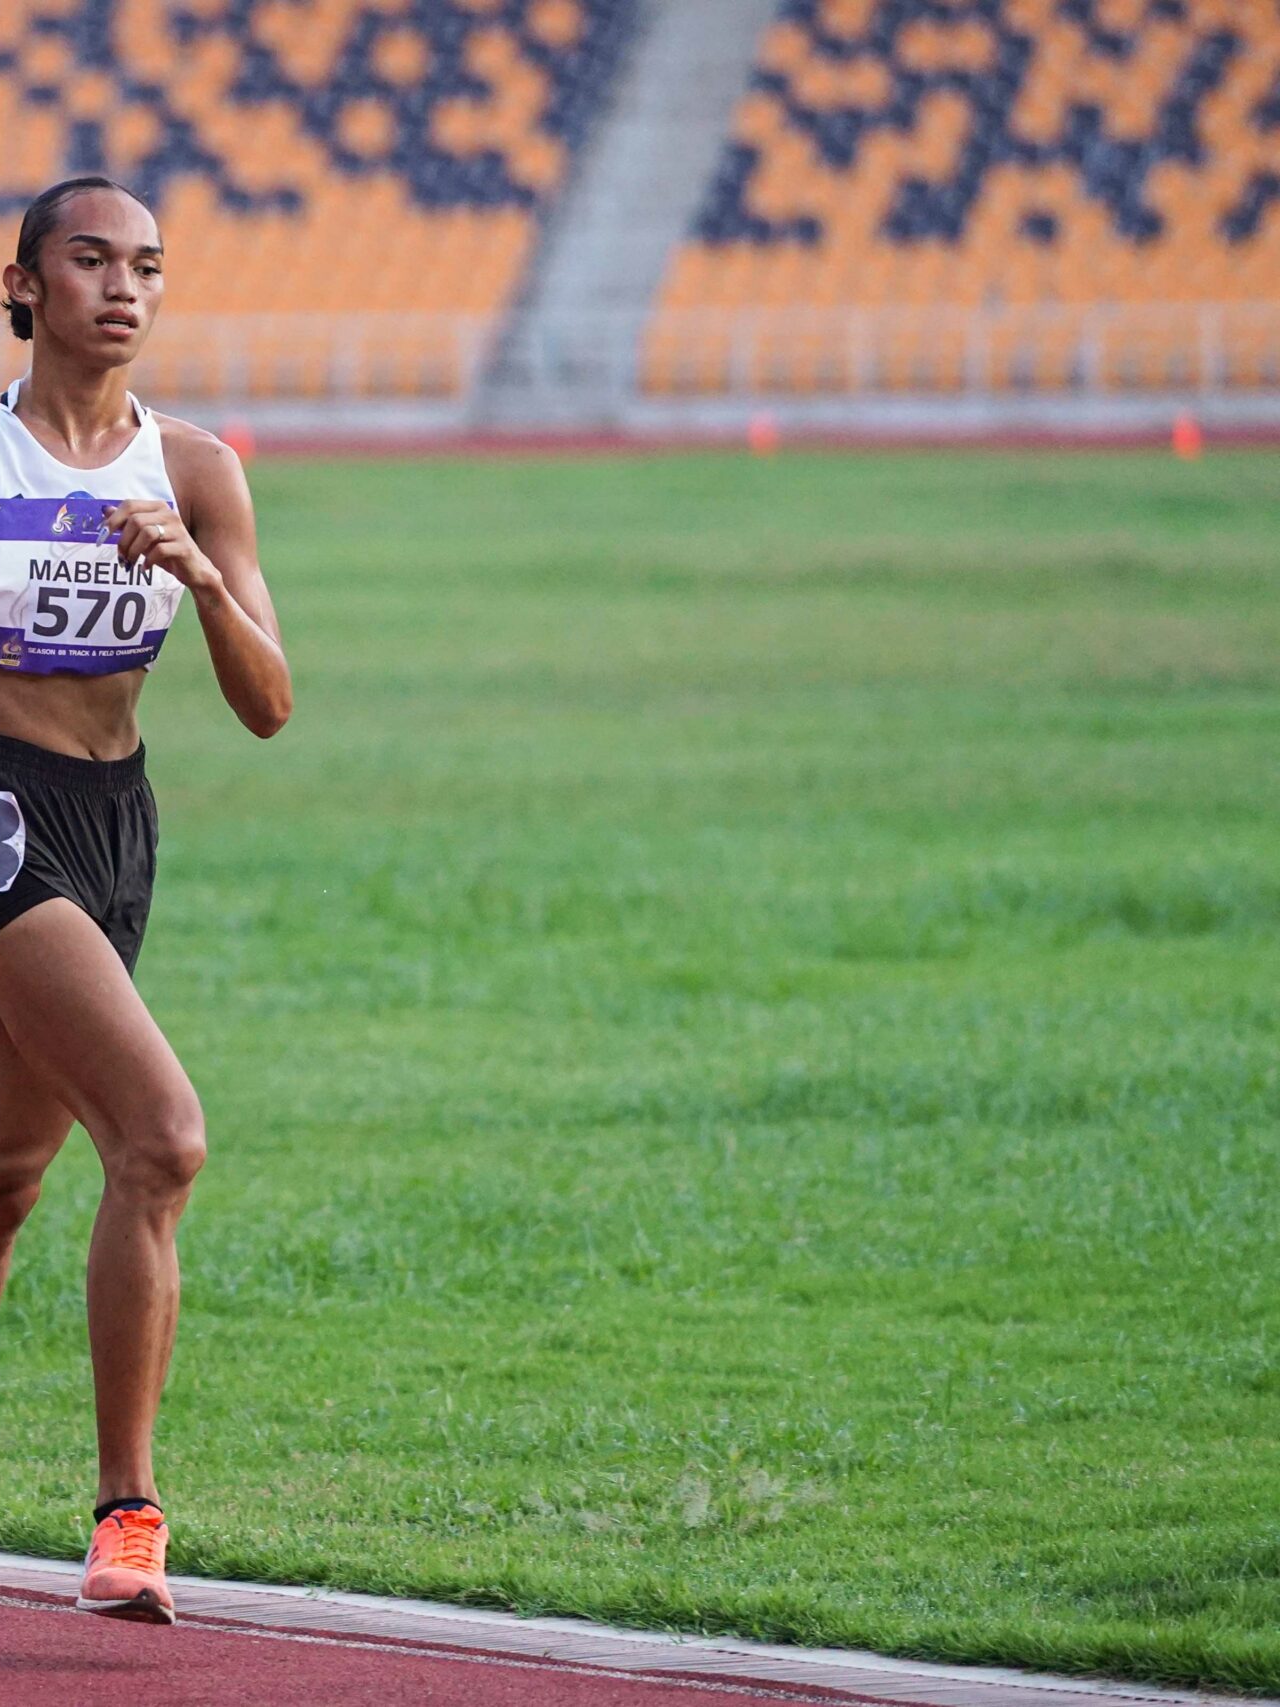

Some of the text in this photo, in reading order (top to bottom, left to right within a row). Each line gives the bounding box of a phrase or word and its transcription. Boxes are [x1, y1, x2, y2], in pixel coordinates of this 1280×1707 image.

[29, 559, 153, 586] MABELIN
[32, 586, 146, 641] 570
[27, 647, 56, 656] SEASON
[68, 649, 90, 657] TRACK
